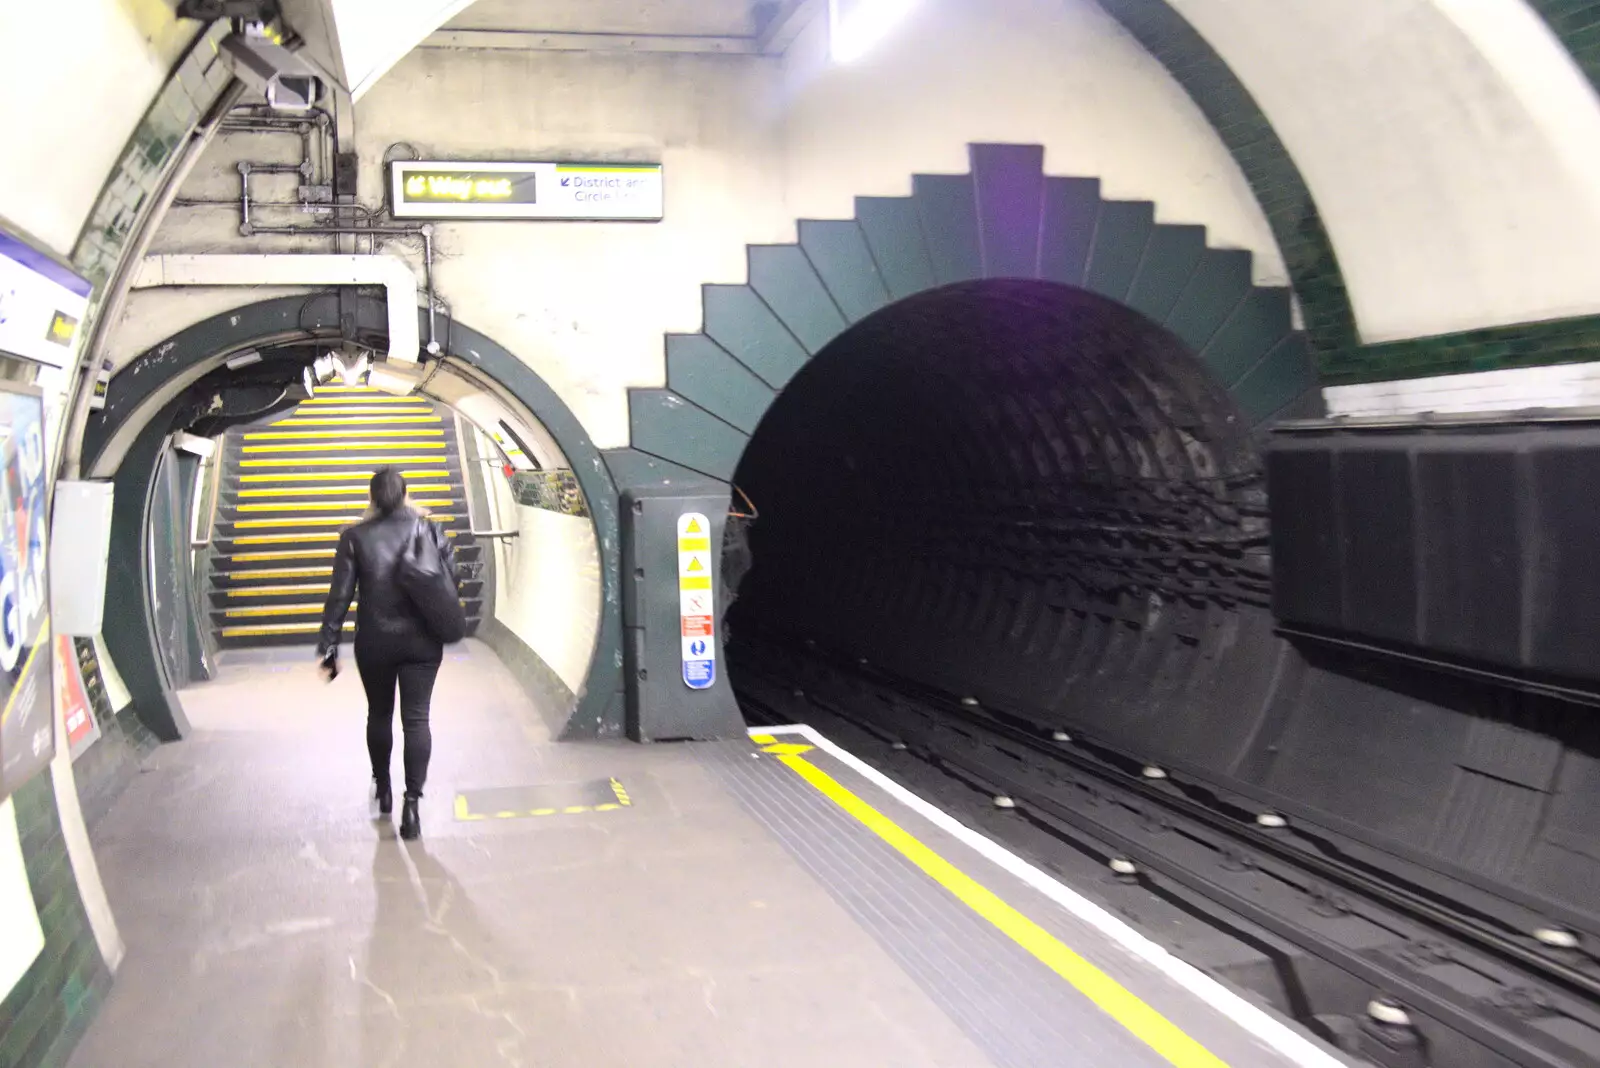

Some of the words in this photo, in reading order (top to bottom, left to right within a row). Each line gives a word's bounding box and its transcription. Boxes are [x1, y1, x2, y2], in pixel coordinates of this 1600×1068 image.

[428, 176, 473, 200] Way
[573, 176, 620, 188] District
[574, 190, 612, 201] Circle
